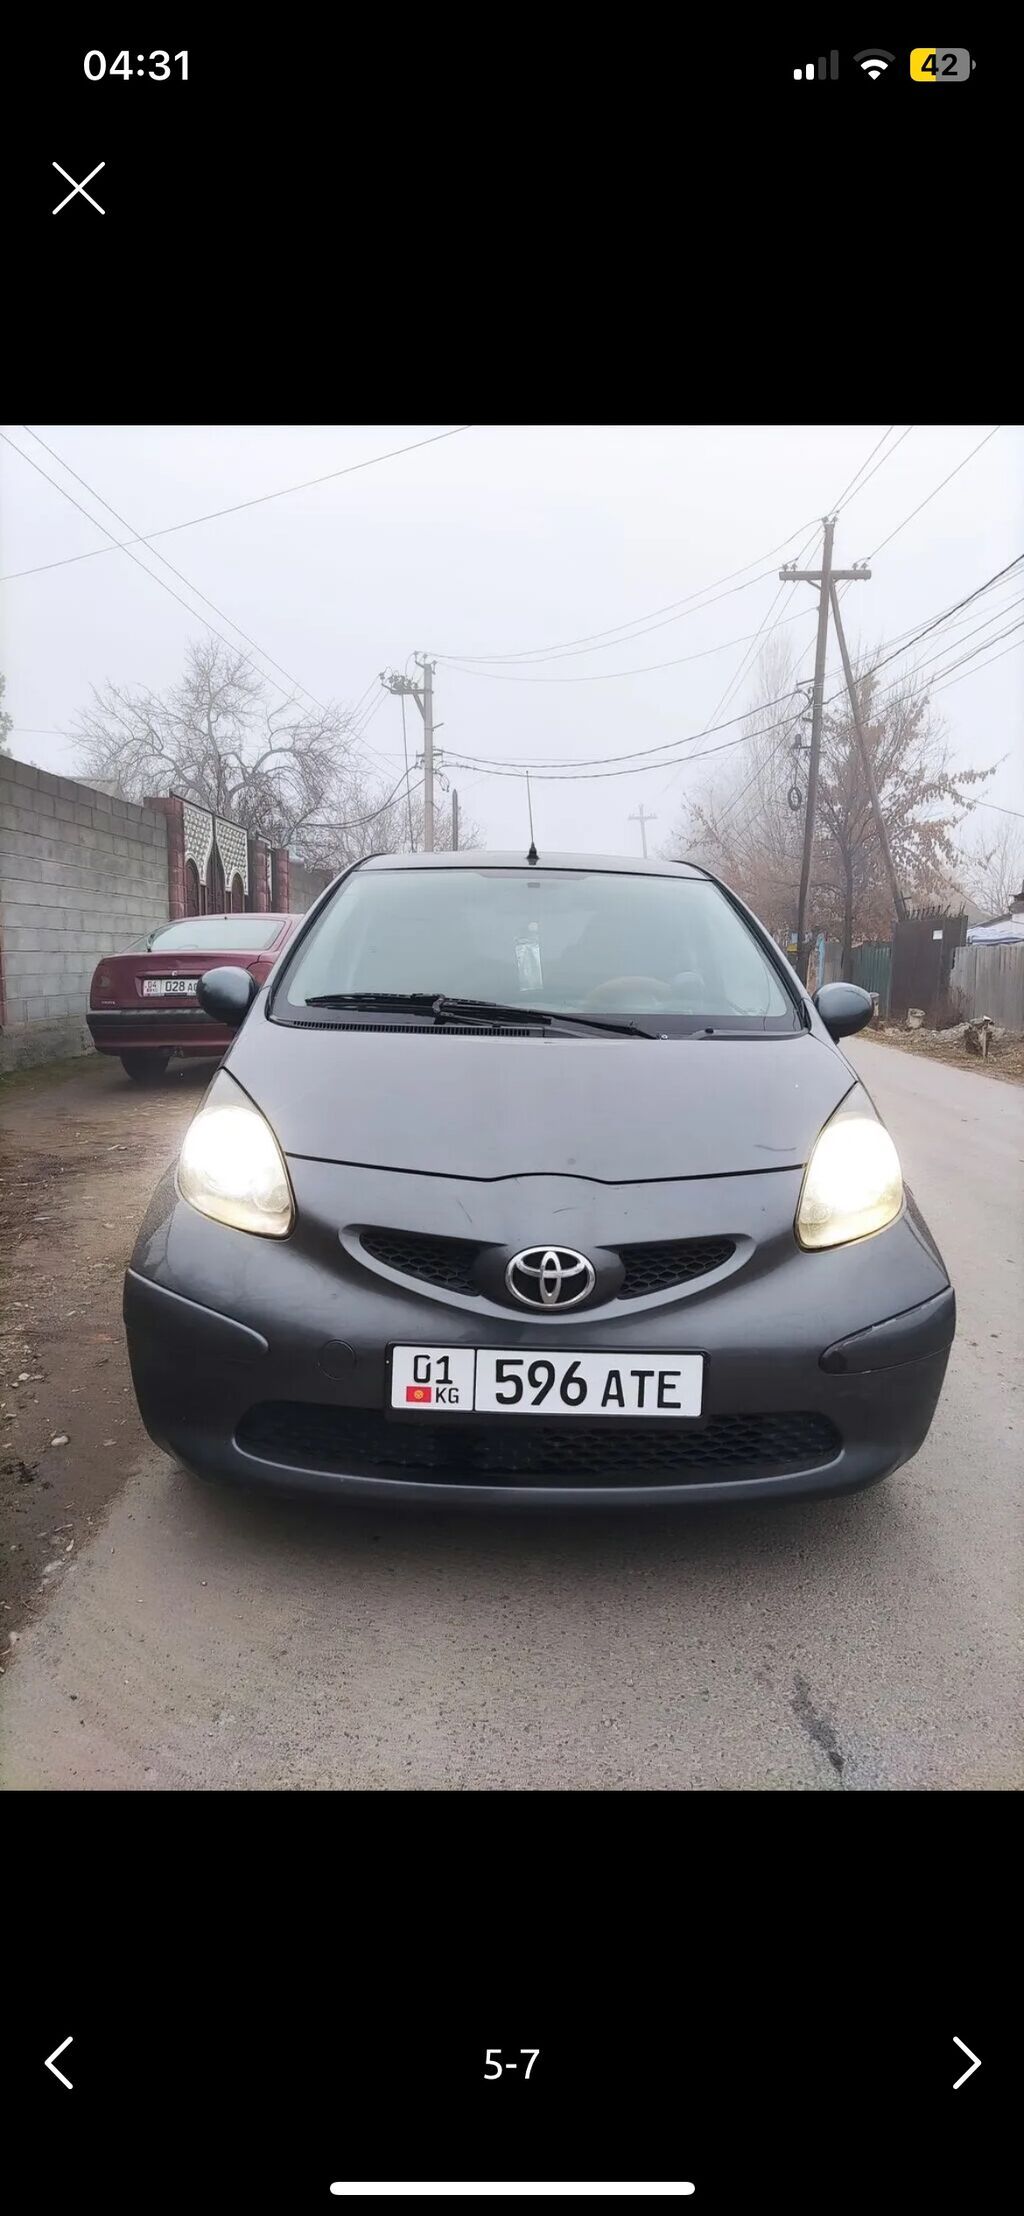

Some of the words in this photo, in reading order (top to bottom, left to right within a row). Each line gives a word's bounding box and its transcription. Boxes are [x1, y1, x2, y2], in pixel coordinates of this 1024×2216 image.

[165, 981, 186, 992] 028
[413, 1354, 453, 1385] 01
[435, 1387, 460, 1404] KG
[495, 1359, 588, 1407] 596
[600, 1369, 682, 1409] ATE
